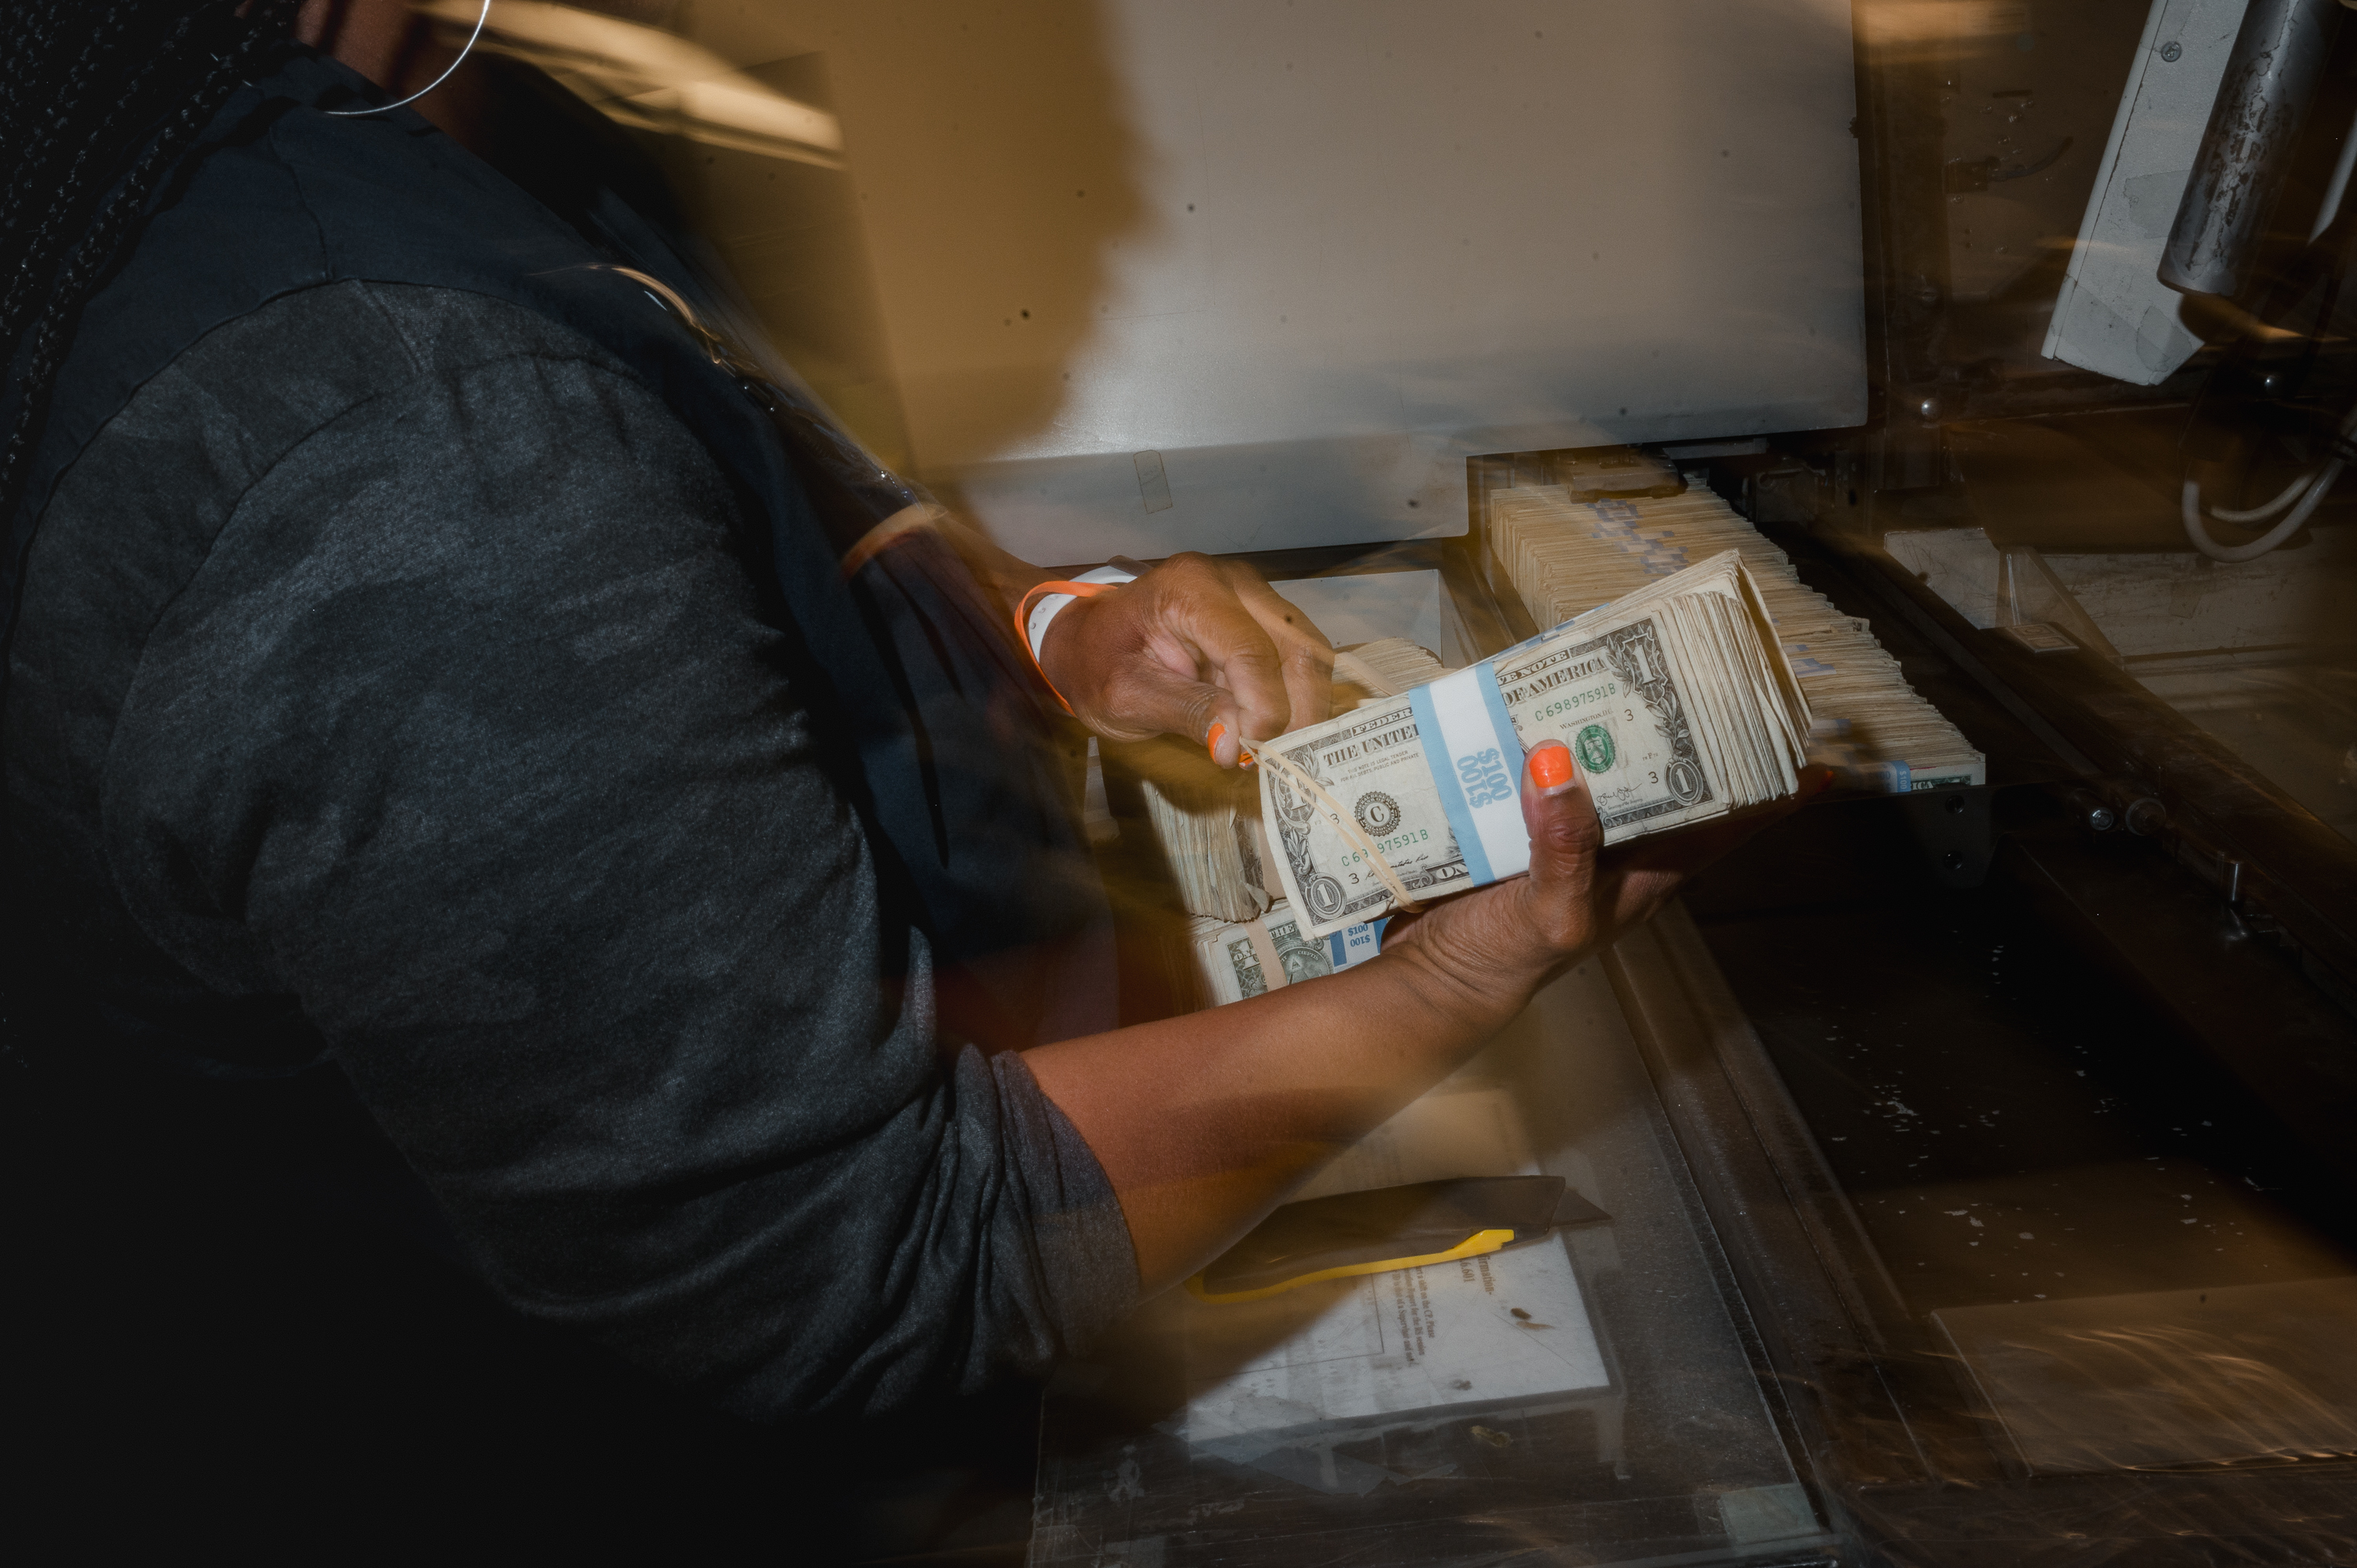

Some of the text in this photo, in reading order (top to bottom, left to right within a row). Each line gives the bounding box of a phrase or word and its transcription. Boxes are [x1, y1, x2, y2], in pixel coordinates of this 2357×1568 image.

[1520, 650, 1567, 676] NOTE
[1527, 657, 1607, 698] AMERICA
[1624, 709, 1634, 722] 3
[1323, 745, 1359, 767] THE
[1373, 762, 1390, 771] PUBLIC
[1401, 752, 1420, 763] PRIVATE
[1376, 756, 1390, 764] LEGAL
[1391, 749, 1409, 760] TENDER
[1648, 771, 1659, 784] 3
[1369, 805, 1385, 822] C
[1348, 872, 1360, 885] 3
[1347, 923, 1369, 937] $100
[1350, 934, 1371, 947] $100
